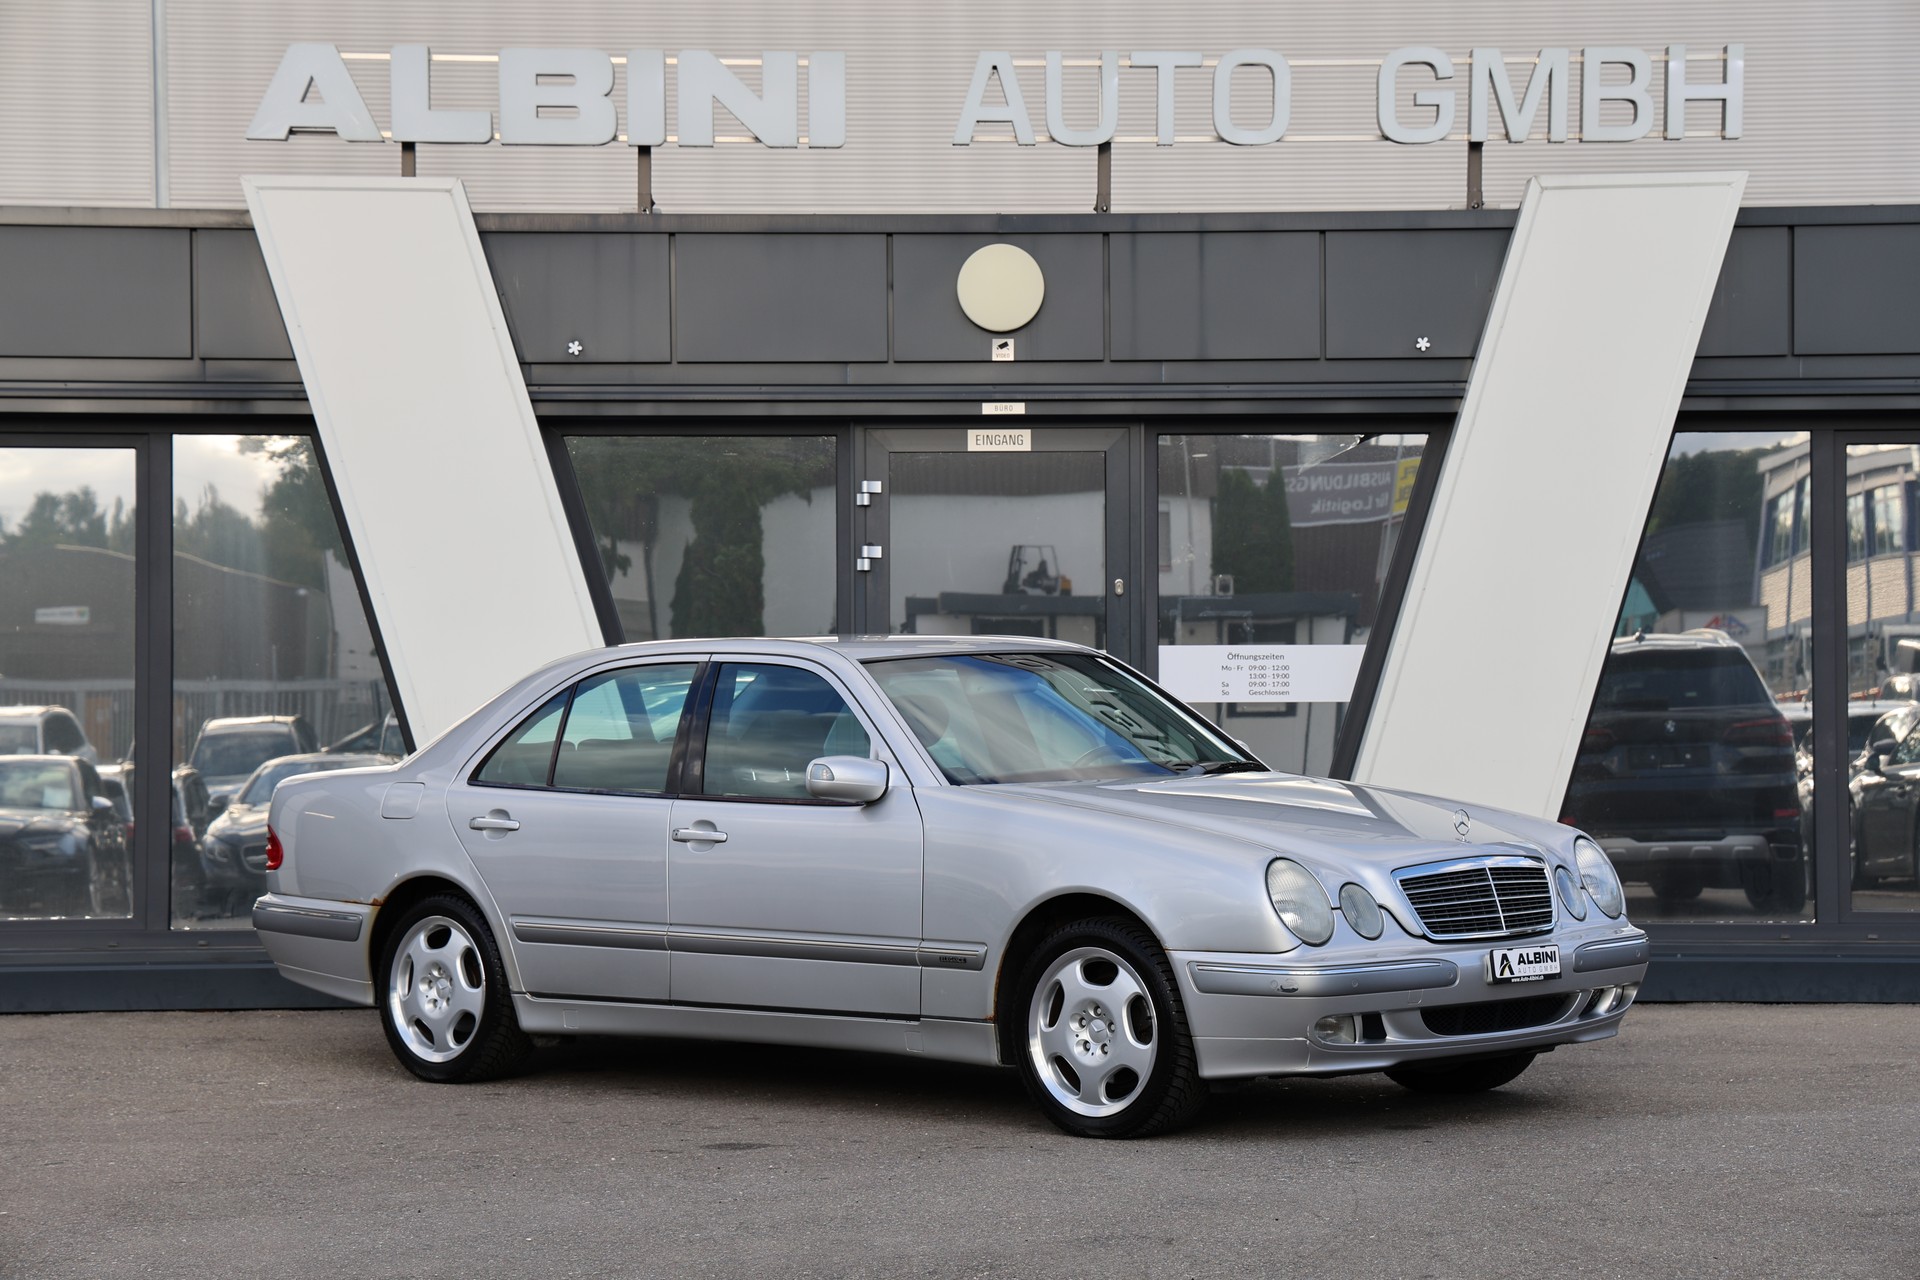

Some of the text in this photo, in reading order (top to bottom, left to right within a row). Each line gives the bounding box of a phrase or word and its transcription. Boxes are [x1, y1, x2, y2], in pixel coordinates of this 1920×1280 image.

[246, 43, 1745, 149] ALBINI AUTO GMBH
[975, 434, 1024, 446] EINGANG
[1227, 652, 1285, 662] Öffnungszeiten
[1517, 950, 1557, 965] ALBINI
[1539, 965, 1558, 973] GMBH
